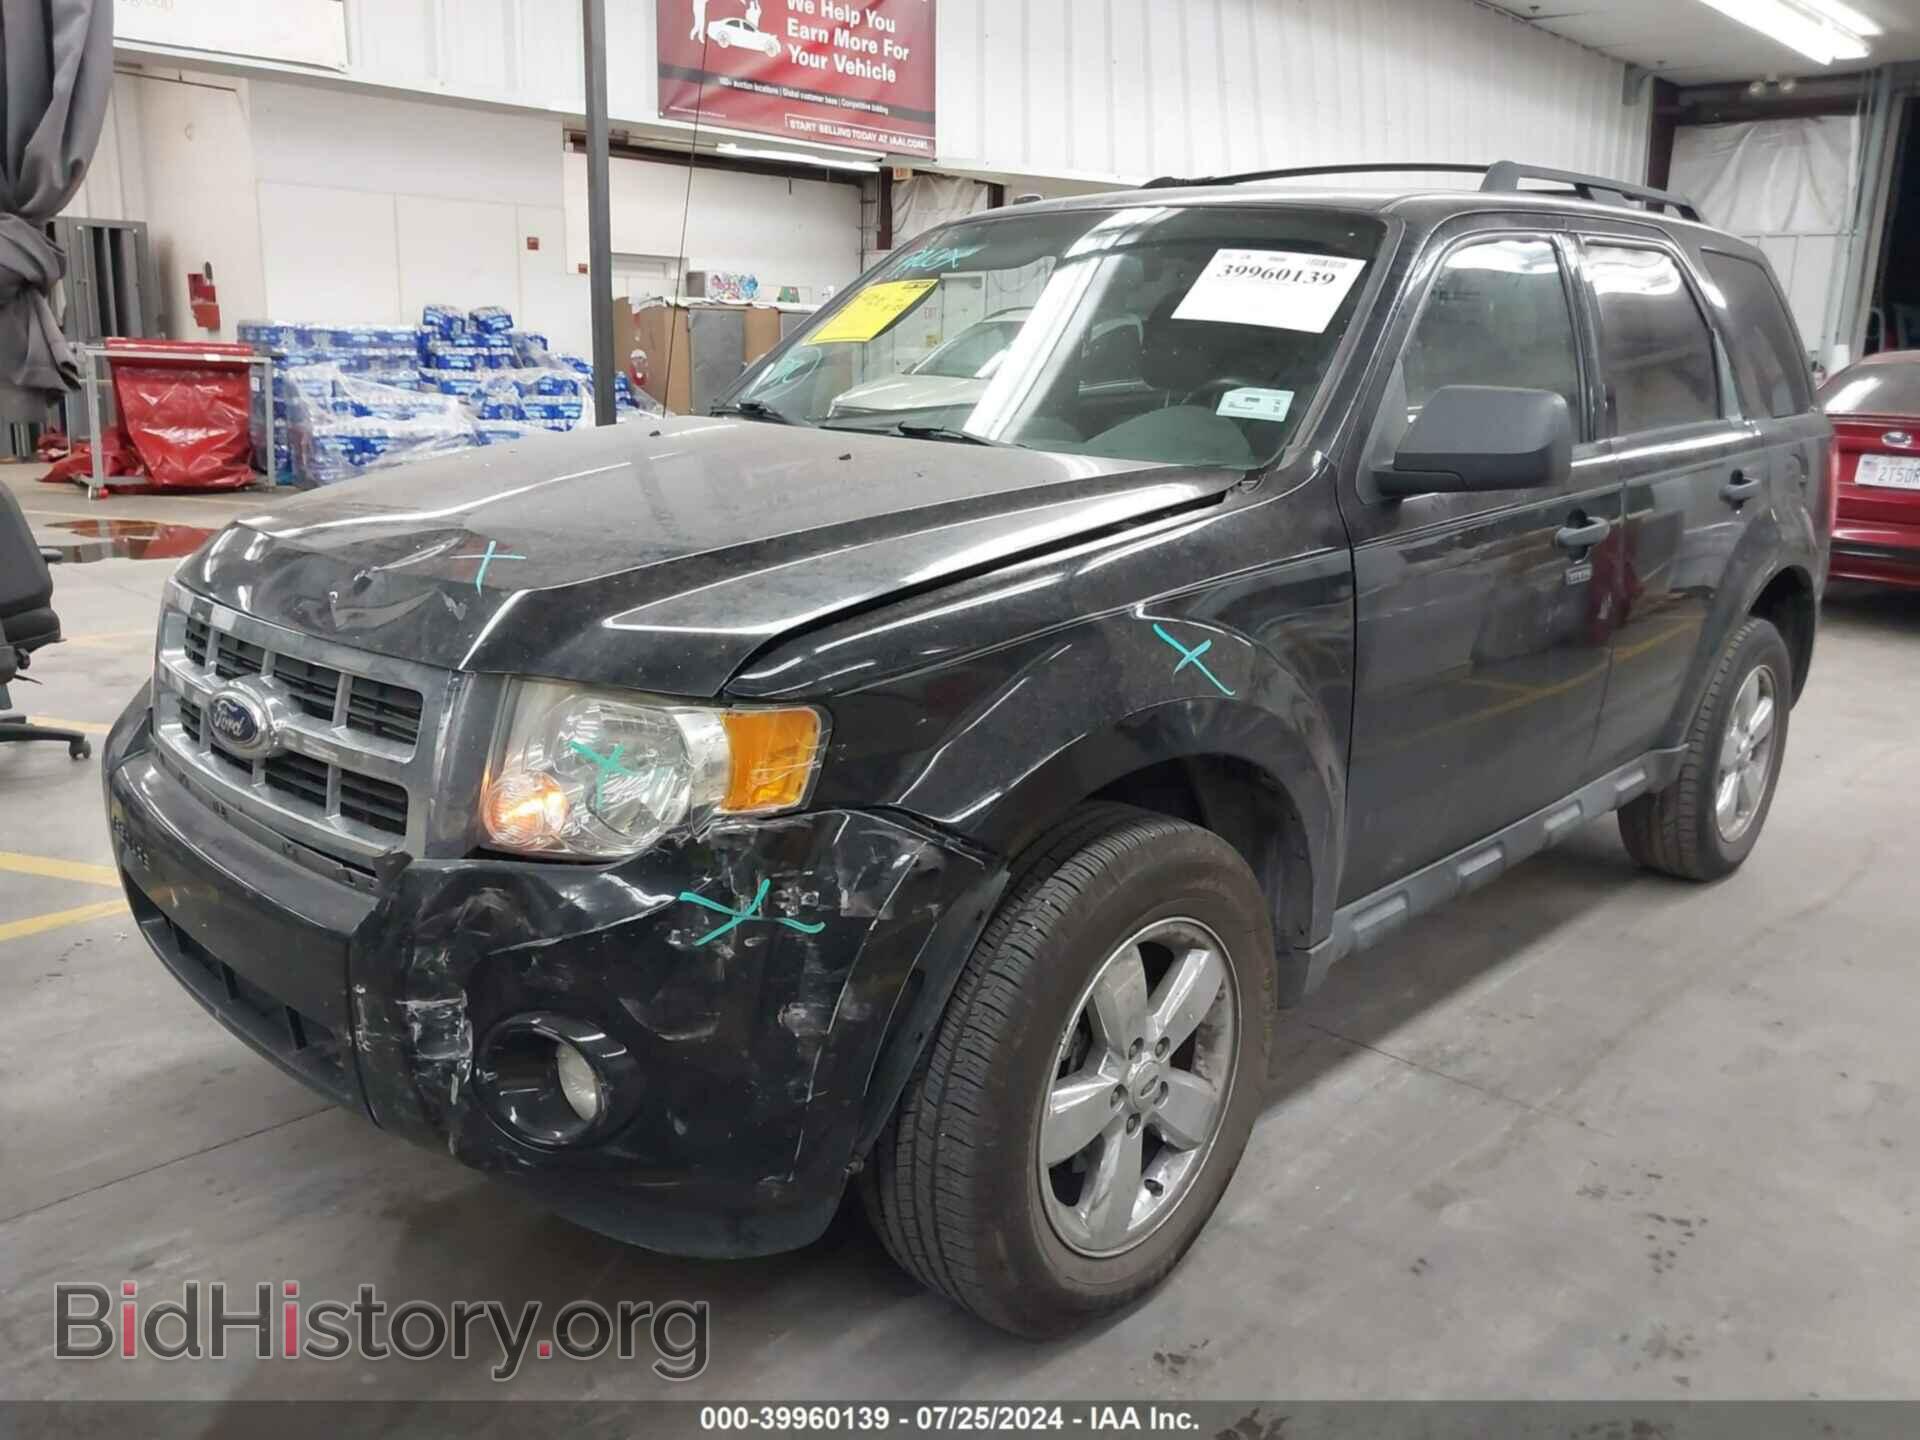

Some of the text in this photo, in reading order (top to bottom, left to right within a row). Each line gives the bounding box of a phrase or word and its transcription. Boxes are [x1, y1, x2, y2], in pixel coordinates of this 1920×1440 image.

[786, 0, 896, 33] We Help You
[787, 17, 910, 60] Earn More For
[788, 43, 897, 83] Your Vehicle
[789, 119, 817, 133] START
[819, 123, 851, 138] SELLING
[852, 127, 877, 142] TODAY
[878, 133, 888, 144] AT
[1216, 264, 1337, 286] 39960139
[213, 700, 245, 737] Ford
